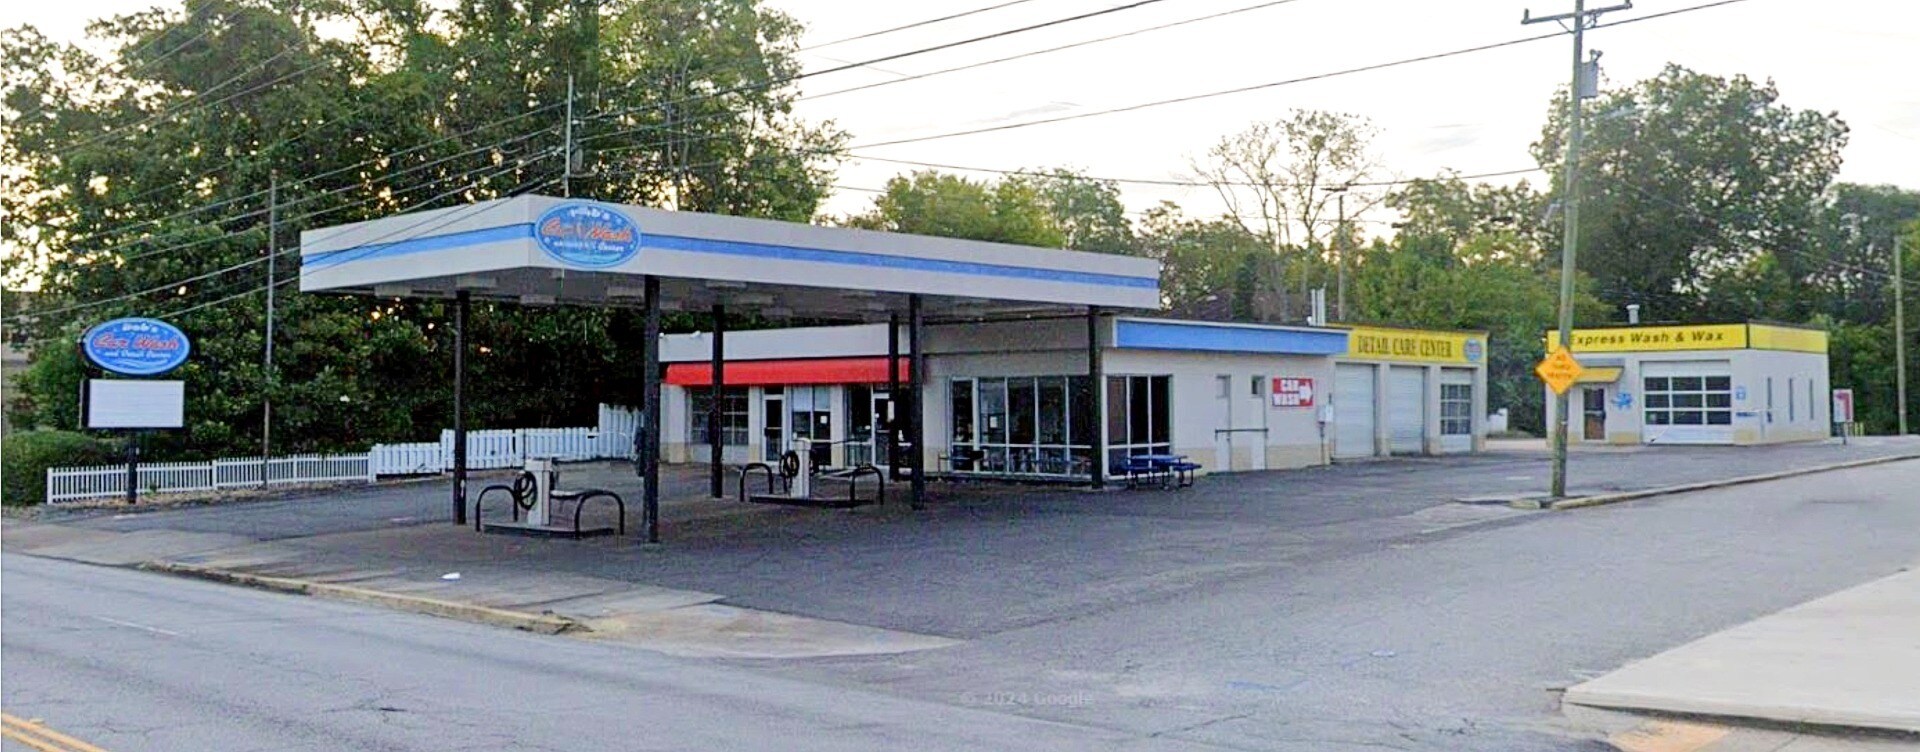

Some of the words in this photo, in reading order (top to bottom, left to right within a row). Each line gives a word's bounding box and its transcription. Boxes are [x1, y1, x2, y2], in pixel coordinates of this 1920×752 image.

[586, 222, 633, 242] Wash
[93, 331, 129, 350] Car
[133, 333, 179, 351] Wash
[1357, 335, 1390, 354] DETAIL
[1392, 338, 1417, 355] CARE
[1419, 339, 1452, 357] CENTER
[1569, 333, 1625, 347] Express
[1630, 332, 1669, 344] Wash
[1674, 331, 1685, 342] &
[1692, 330, 1724, 342] Wax
[1280, 380, 1299, 391] CAR
[1272, 392, 1299, 405] WASH
